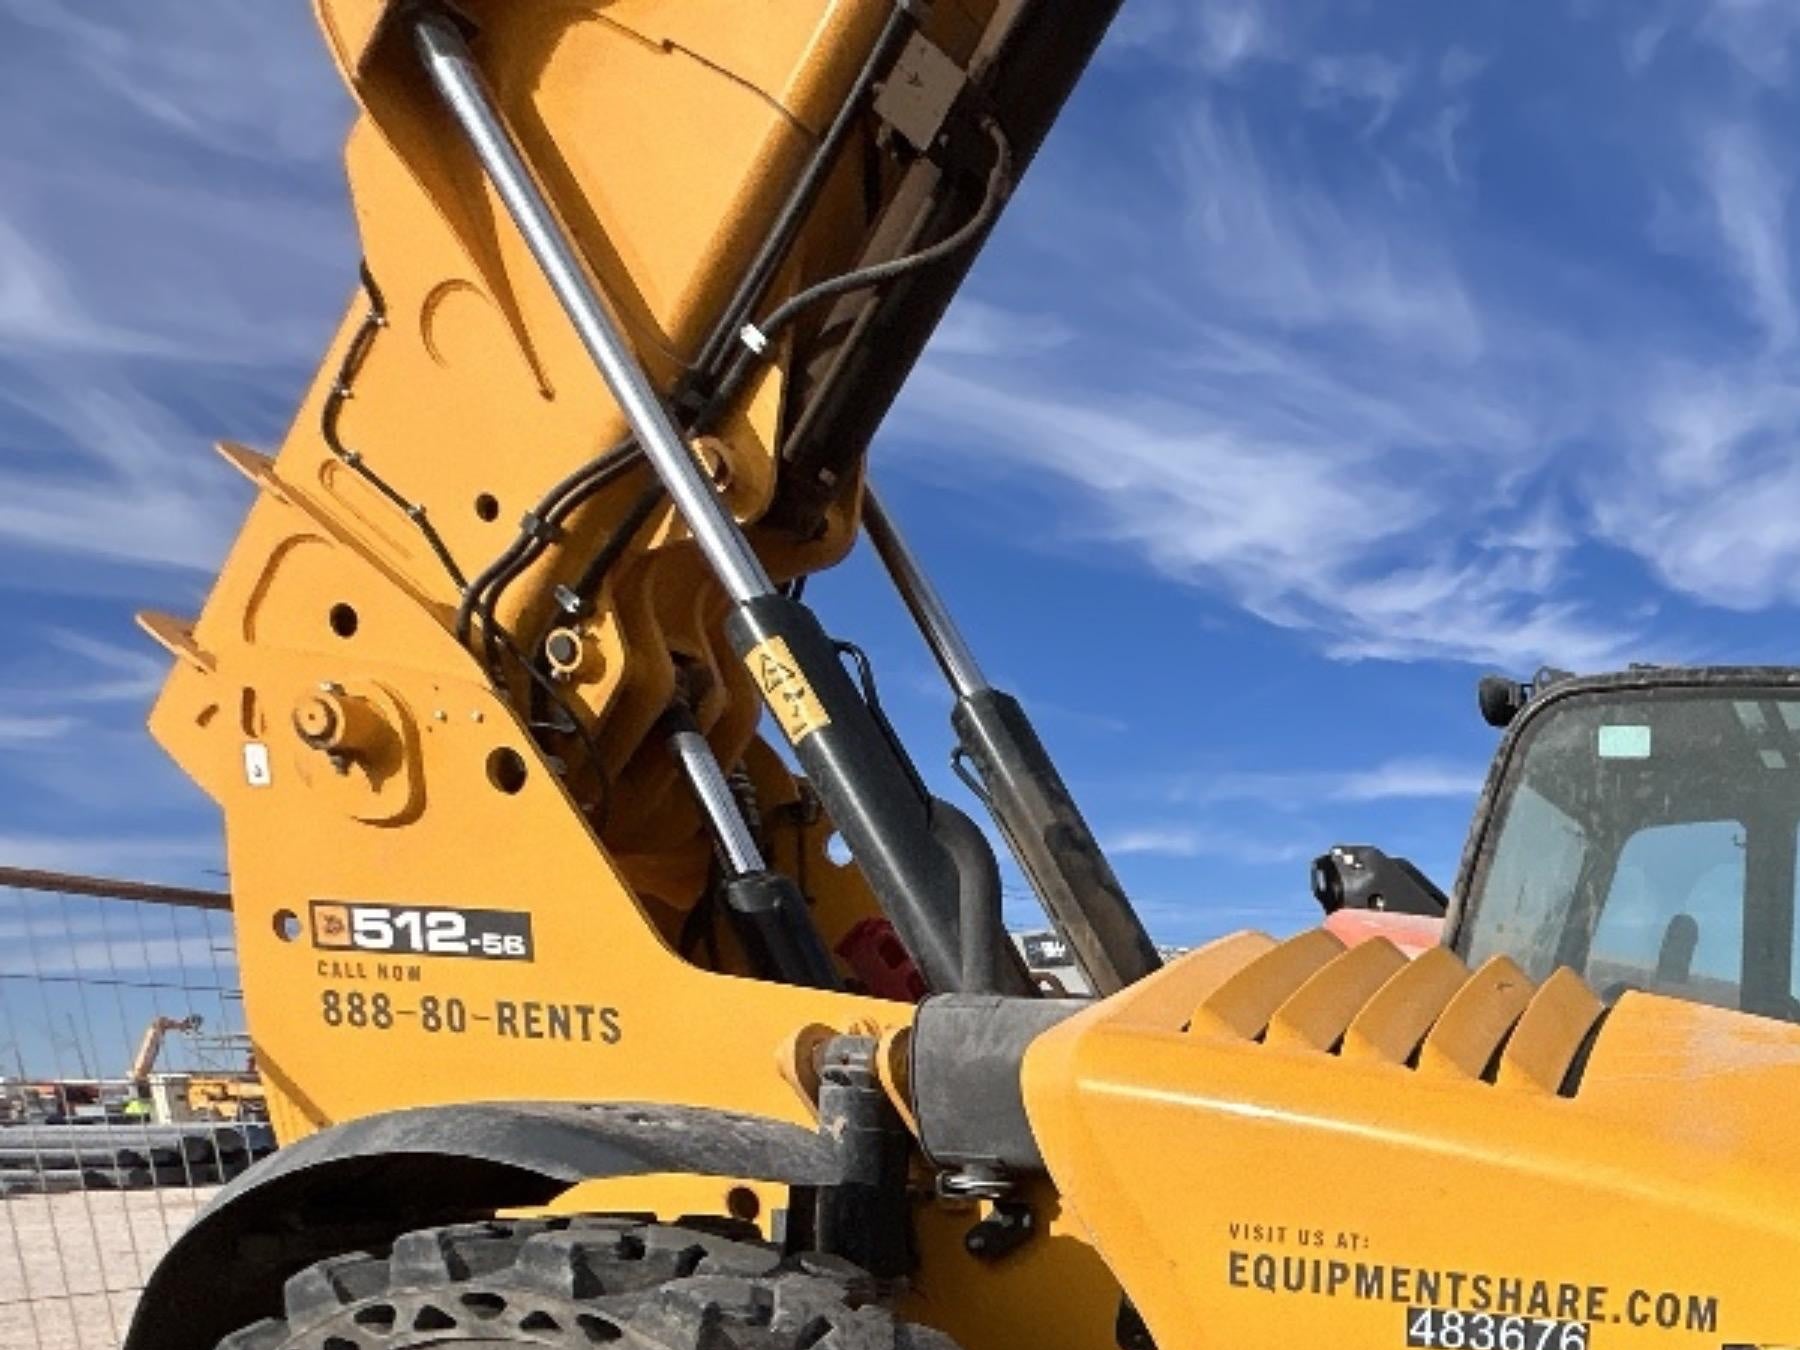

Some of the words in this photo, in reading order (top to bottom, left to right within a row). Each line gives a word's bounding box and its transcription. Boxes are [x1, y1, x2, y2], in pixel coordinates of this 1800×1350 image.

[317, 959, 367, 979] CALL
[377, 962, 422, 982] NOW
[321, 989, 622, 1044] 888-80-RENTS
[1229, 1223, 1287, 1244] VISIT
[1298, 1229, 1325, 1246] US
[1335, 1232, 1370, 1250] AT:
[1229, 1250, 1718, 1333] EQUIPMENTSHARE.COM
